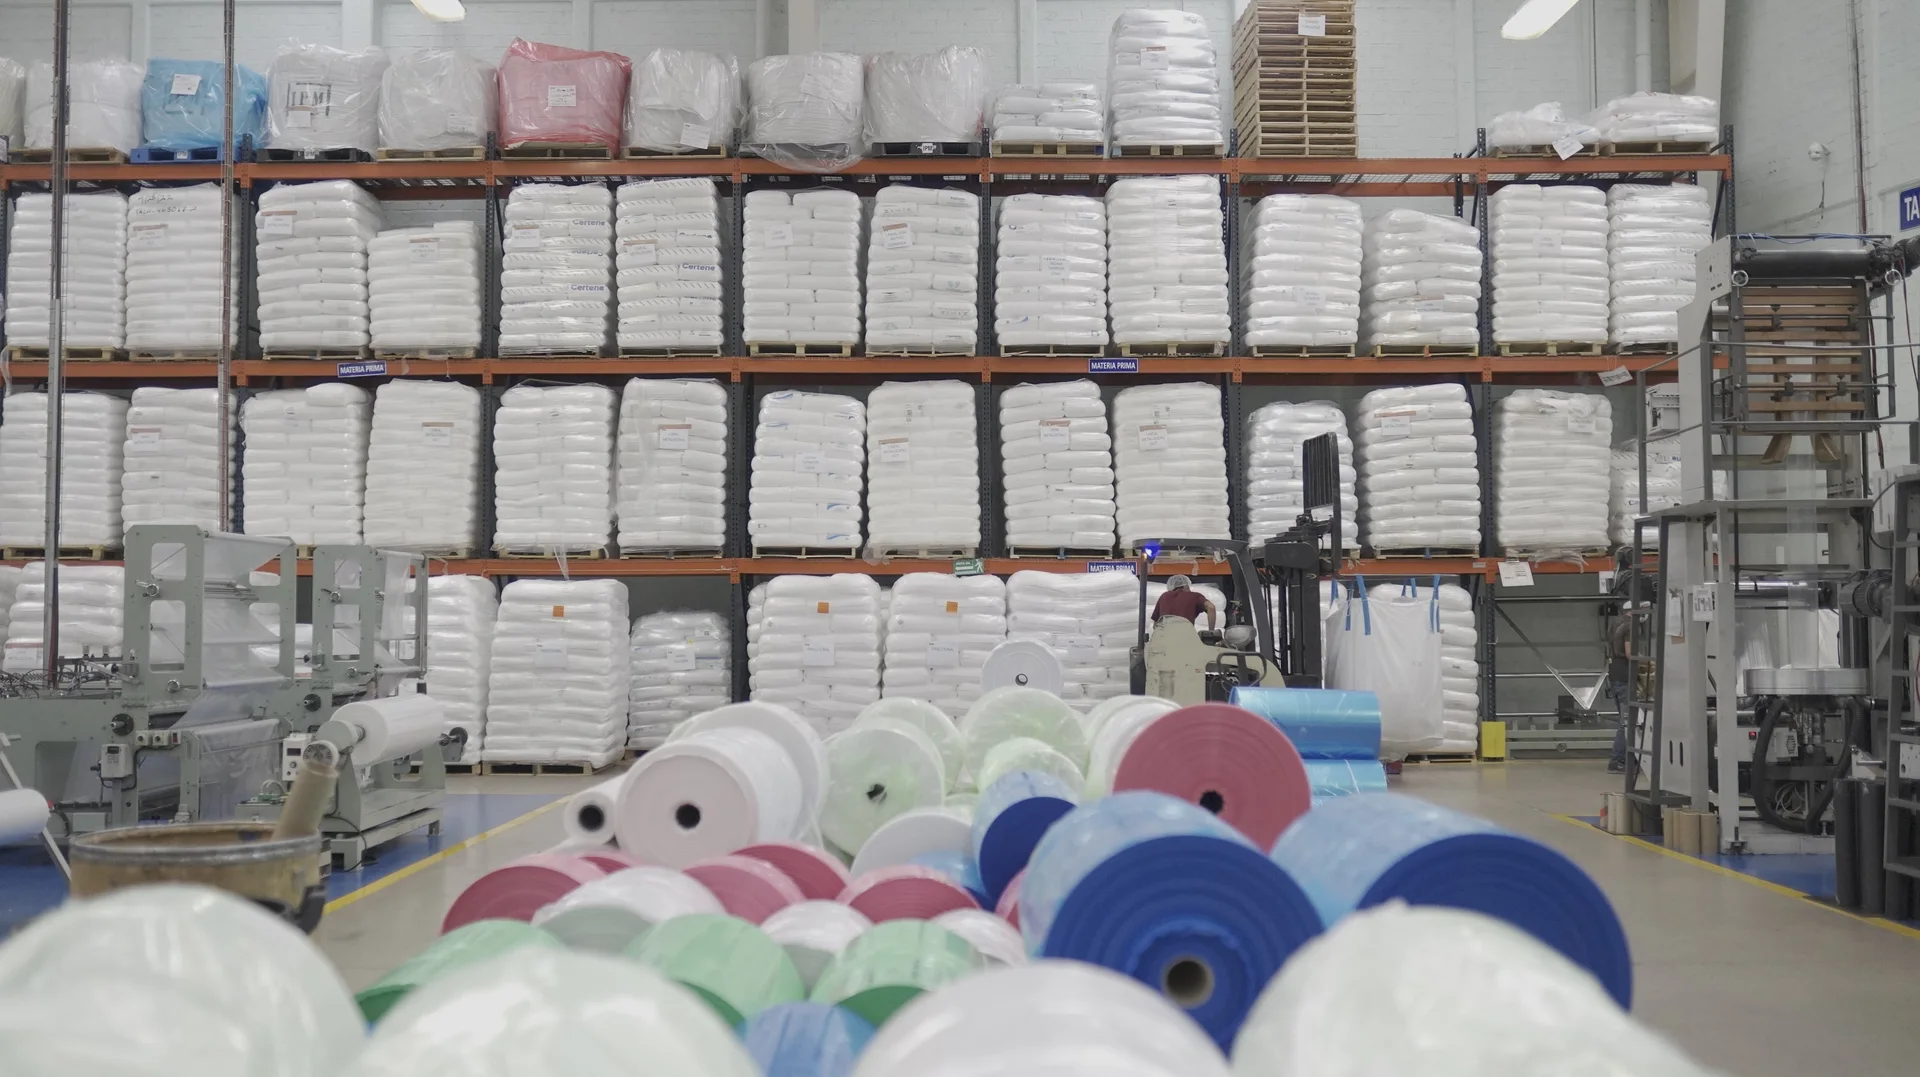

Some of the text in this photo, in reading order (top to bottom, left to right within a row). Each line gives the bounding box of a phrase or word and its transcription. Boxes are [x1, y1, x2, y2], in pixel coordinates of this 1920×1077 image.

[682, 262, 716, 271] Certene
[570, 284, 605, 292] Certene
[339, 363, 384, 374] MATERIA PRIMA
[1091, 361, 1136, 370] MATERIA PRIMA
[1090, 564, 1135, 573] MATERIA PRIMA
